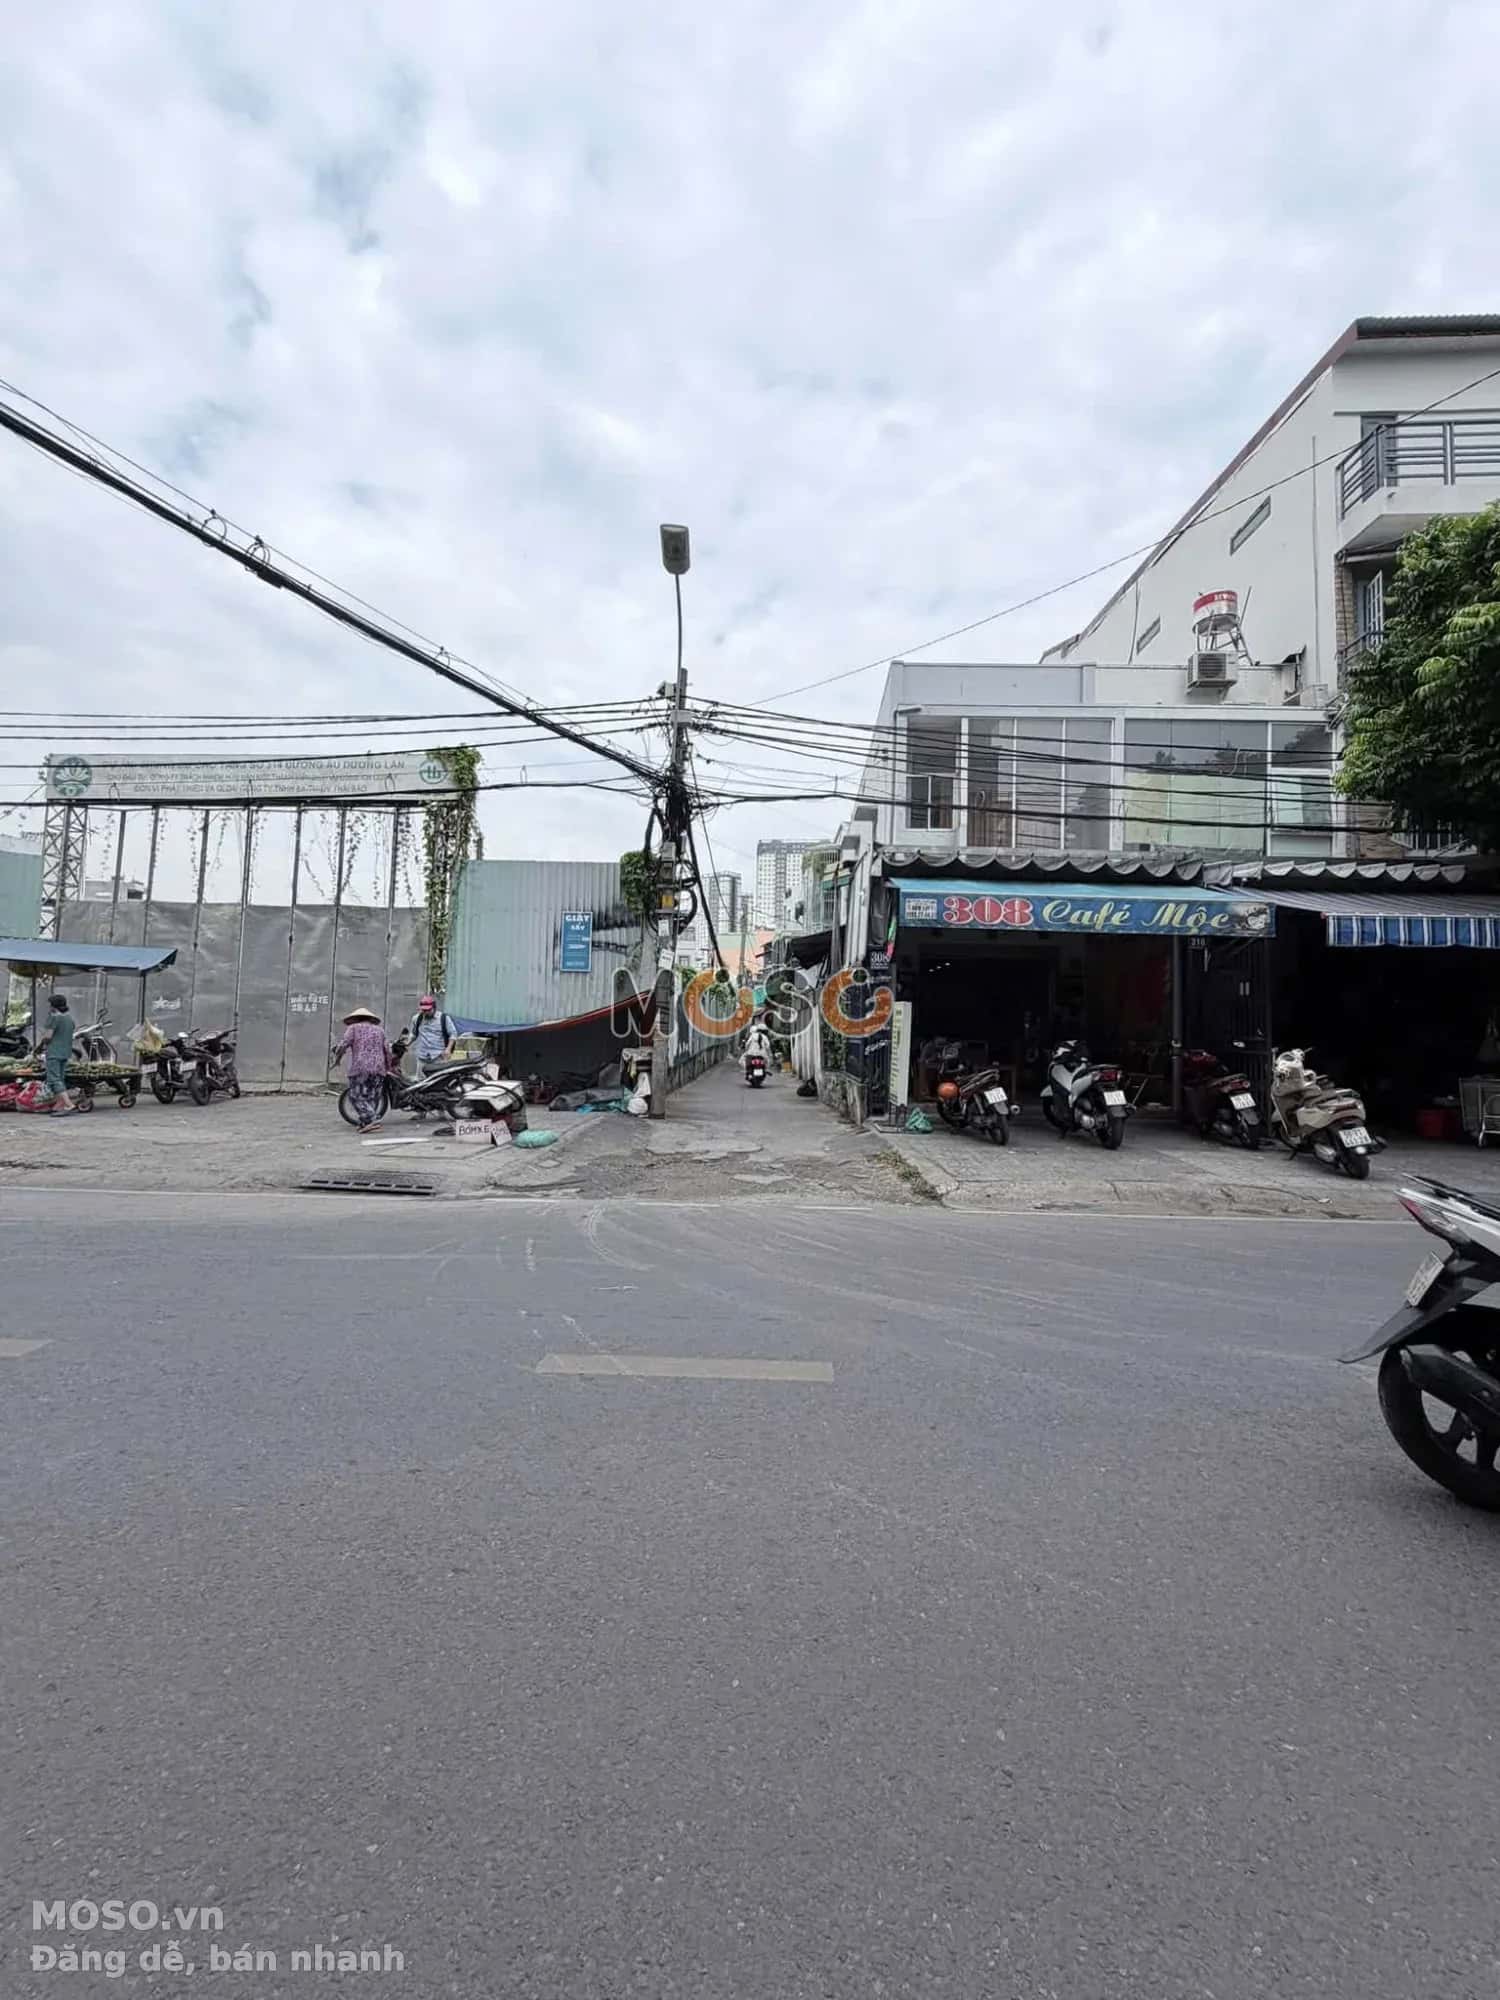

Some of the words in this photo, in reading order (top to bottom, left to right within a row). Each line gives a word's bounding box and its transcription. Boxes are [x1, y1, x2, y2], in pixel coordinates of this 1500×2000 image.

[943, 895, 1034, 926] 308
[1042, 898, 1132, 930] Café
[1141, 903, 1235, 936] Mộc
